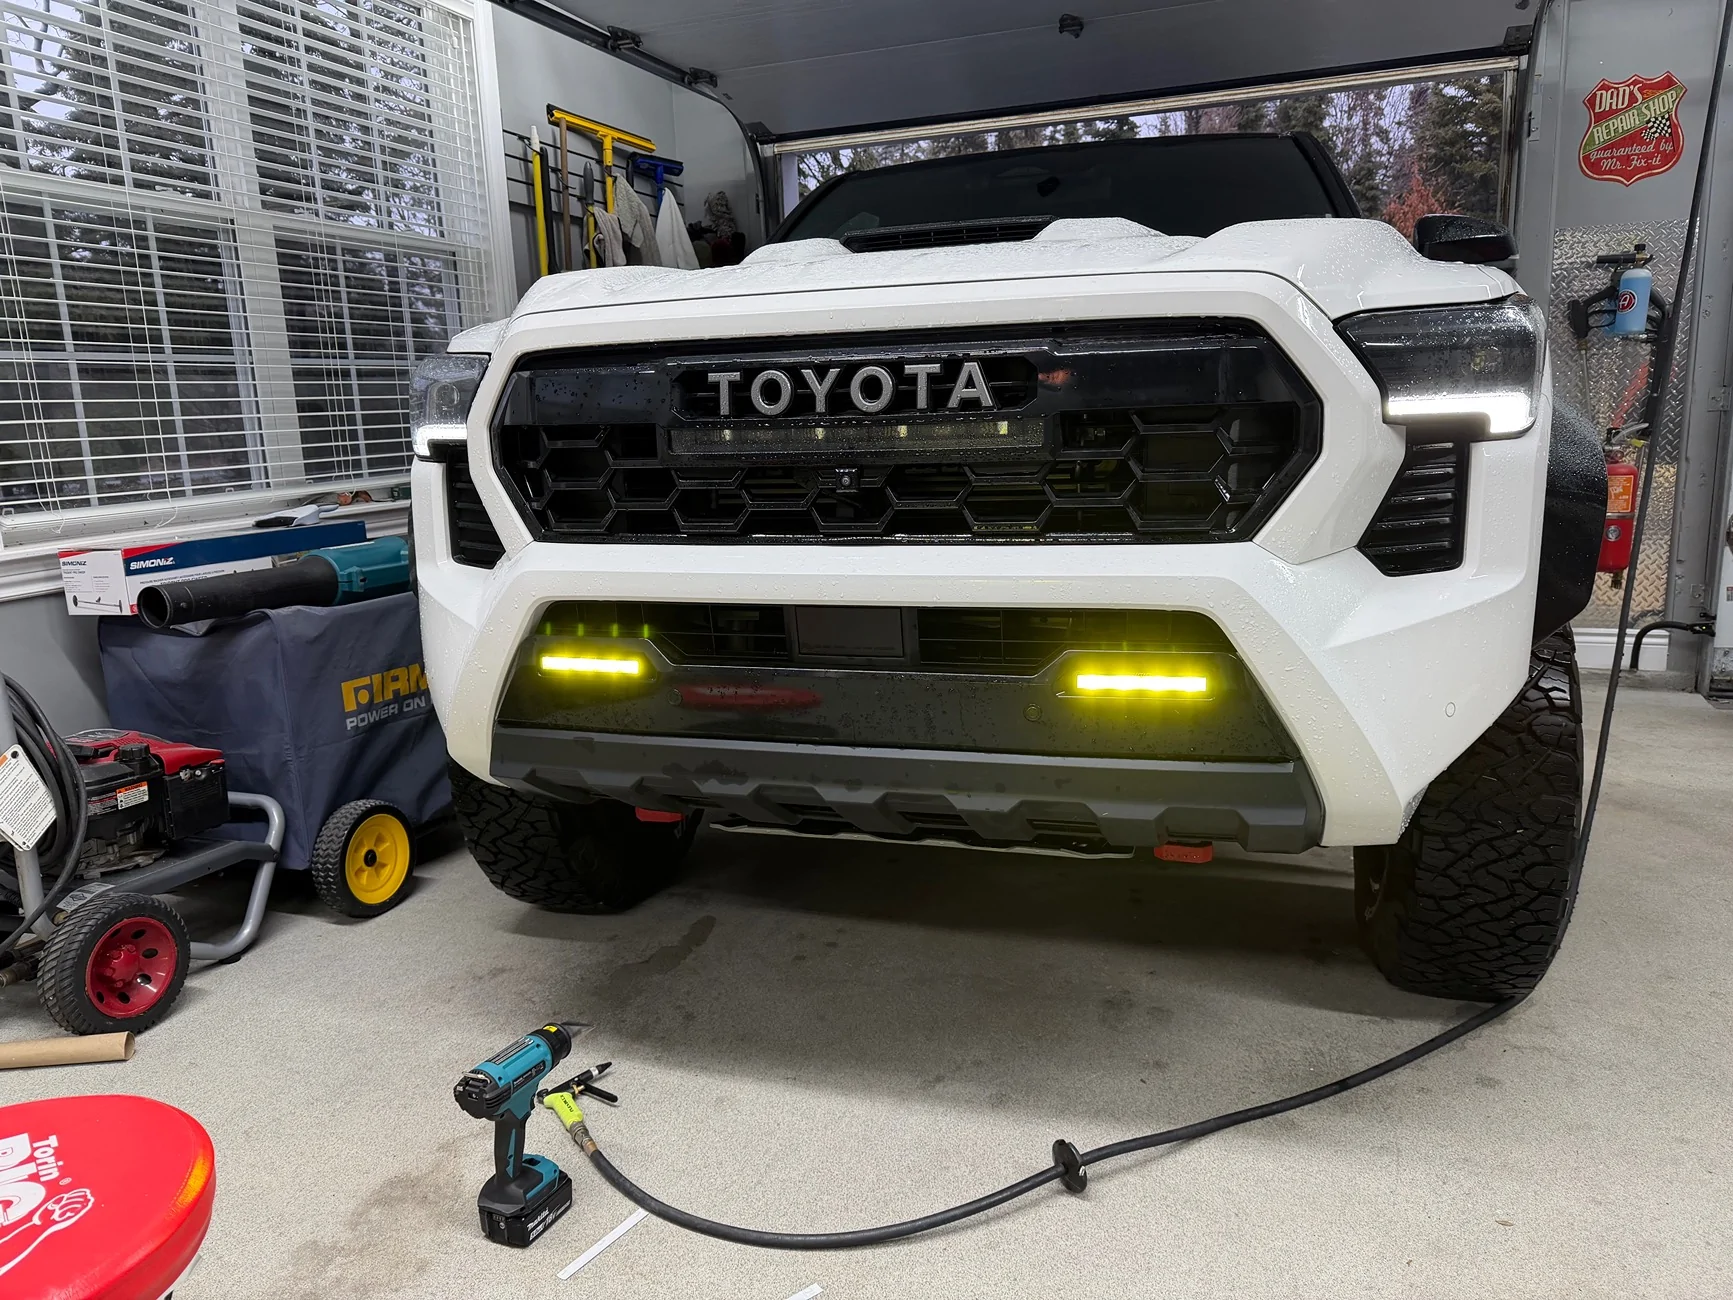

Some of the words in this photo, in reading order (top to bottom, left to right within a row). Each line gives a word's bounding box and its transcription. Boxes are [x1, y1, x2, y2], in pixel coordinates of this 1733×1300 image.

[1595, 84, 1642, 112] DAD'S
[1593, 110, 1639, 144] REPAIR
[1642, 90, 1676, 121] SHOP
[1590, 140, 1655, 162] guaranteed
[1660, 139, 1673, 153] by
[1601, 158, 1625, 171] Mr.
[1627, 153, 1661, 170] Fix-it
[707, 361, 994, 416] TOYOTA
[129, 557, 173, 570] SIMONIZ
[346, 703, 398, 730] POWER
[403, 696, 426, 712] ON
[32, 1135, 64, 1182] Torin
